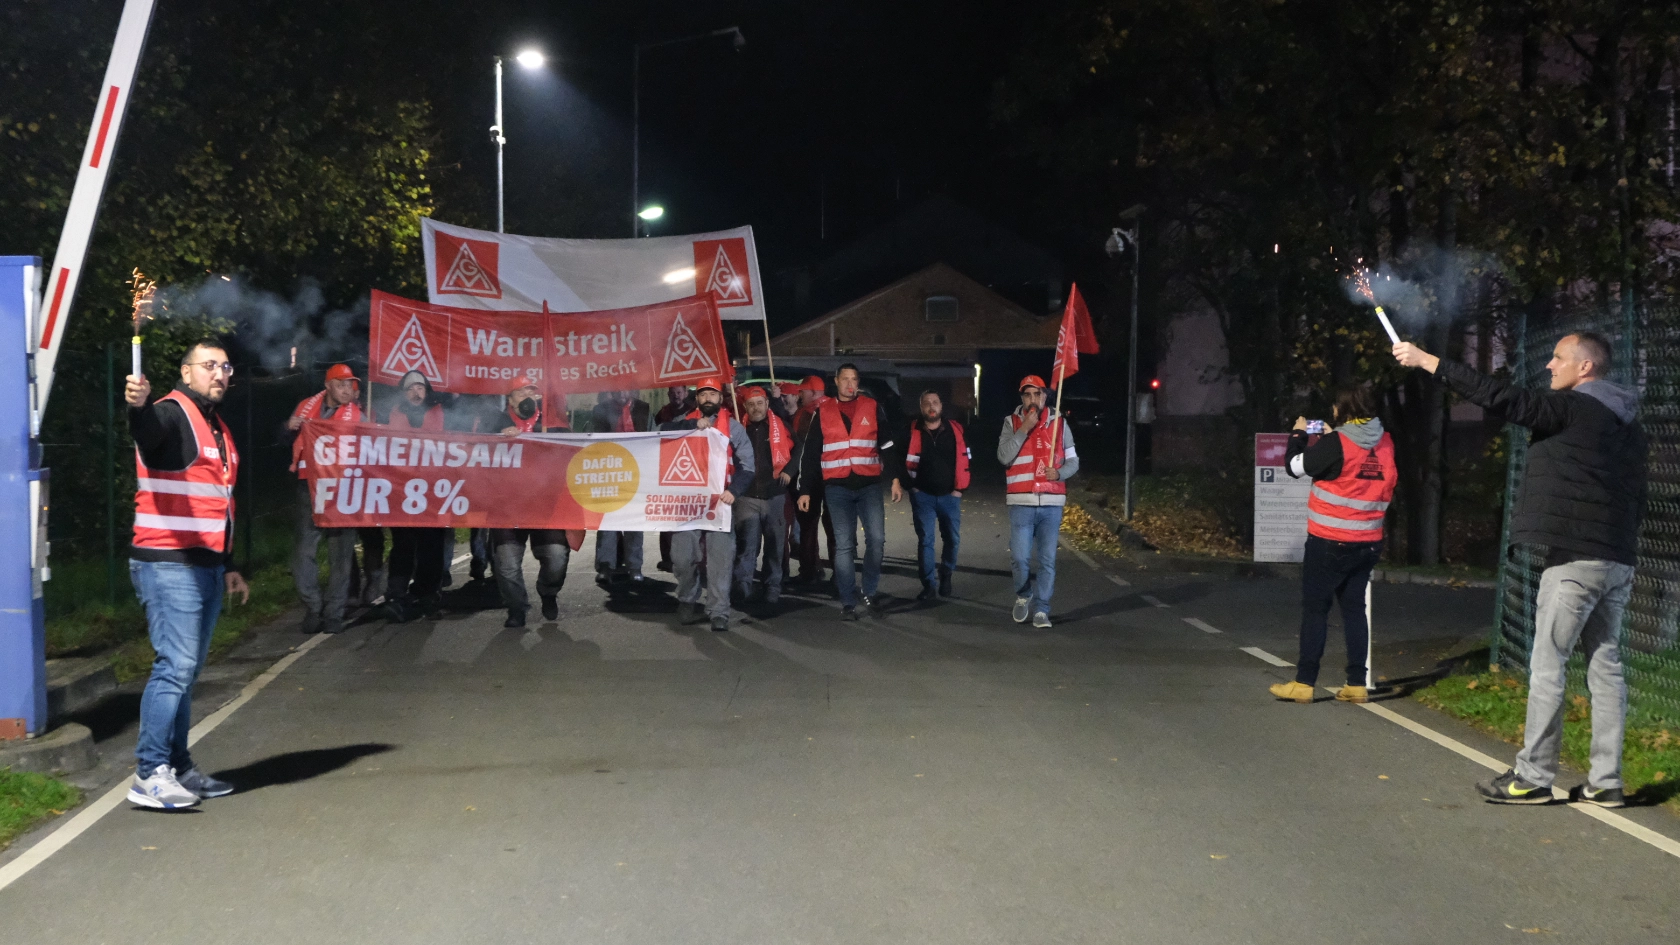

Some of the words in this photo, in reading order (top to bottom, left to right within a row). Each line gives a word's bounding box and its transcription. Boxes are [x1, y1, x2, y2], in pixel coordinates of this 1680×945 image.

[466, 323, 638, 357] Warnstreik
[465, 364, 520, 380] unser
[526, 366, 580, 385] ges
[587, 359, 638, 378] Recht
[314, 434, 524, 468] GEMEINSAM
[582, 455, 623, 471] DAFÜR
[574, 470, 633, 485] STREITEN
[1263, 470, 1272, 481] P
[314, 468, 393, 515] FÜR
[590, 485, 619, 499] WIR!
[1260, 487, 1285, 496] Waage
[645, 494, 708, 504] SOLIDARITÄT
[1260, 500, 1307, 508] Wareneingan
[1260, 512, 1308, 520] Sanitätsstatio
